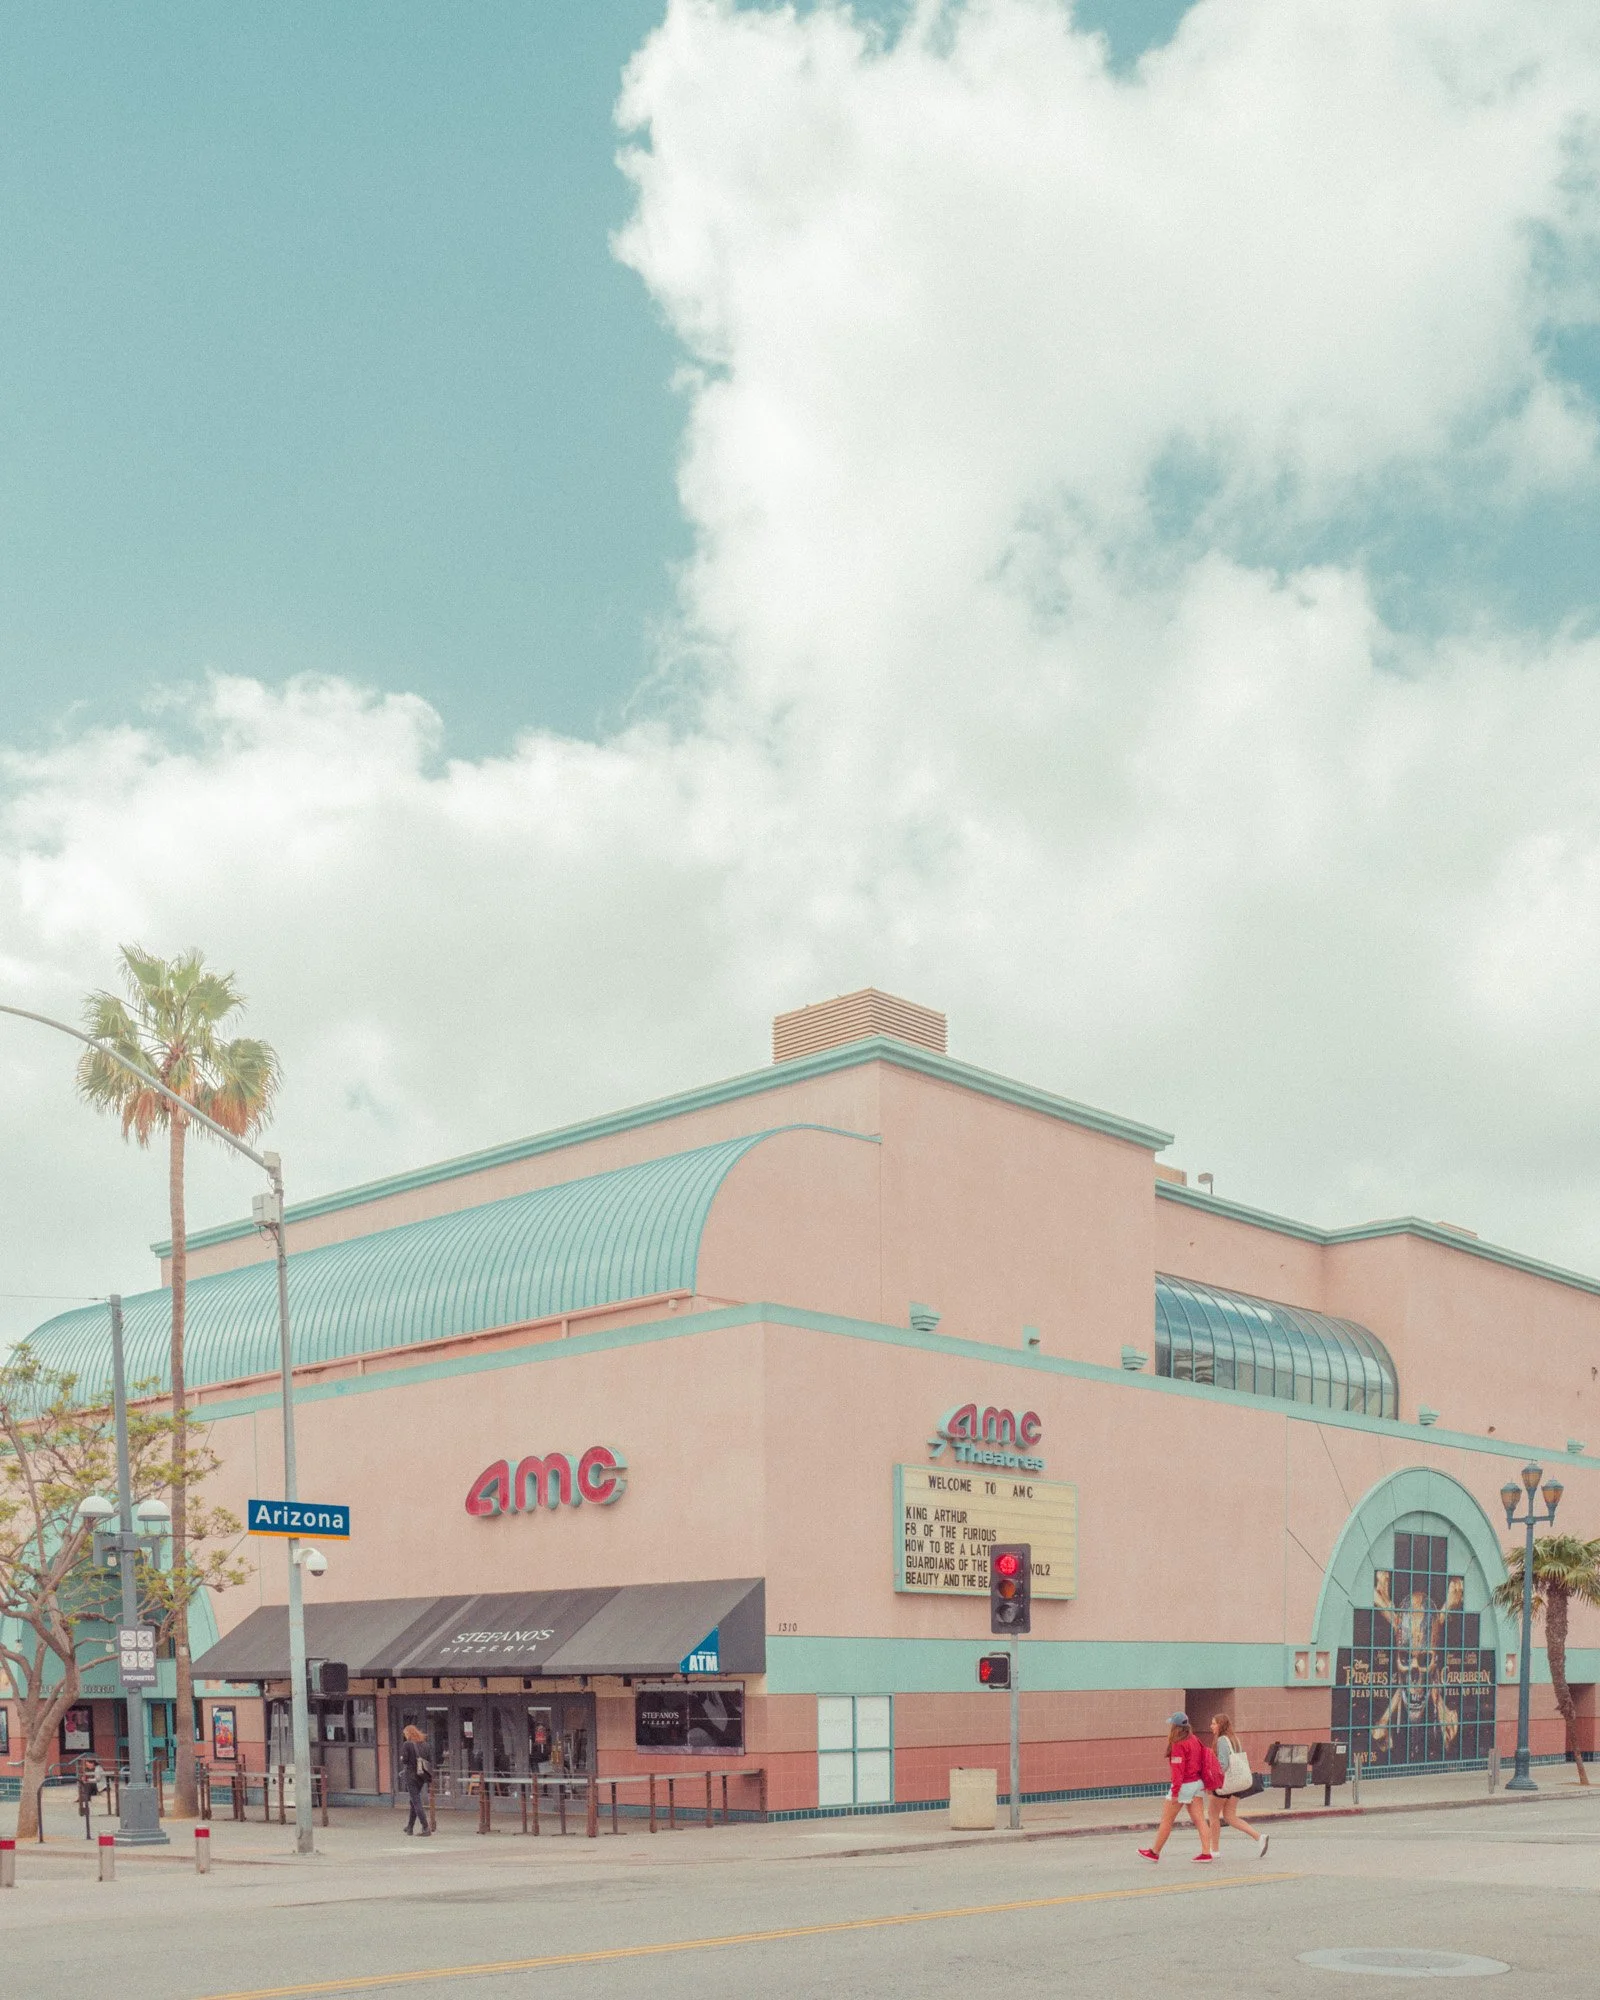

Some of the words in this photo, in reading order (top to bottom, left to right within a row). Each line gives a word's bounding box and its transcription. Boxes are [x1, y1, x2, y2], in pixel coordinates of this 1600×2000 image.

[940, 1403, 1042, 1446] AMC
[927, 1438, 947, 1458] 7
[952, 1442, 1045, 1470] Theatres
[465, 1445, 626, 1517] AMC
[928, 1475, 972, 1493] WELCOME
[985, 1481, 997, 1495] TO
[1012, 1485, 1034, 1499] AMC
[255, 1504, 344, 1529] Arizona
[906, 1506, 928, 1521] KING
[934, 1510, 968, 1524] ARTHUR
[905, 1522, 917, 1536] F8
[924, 1524, 934, 1537] OF
[940, 1525, 957, 1539] THE
[963, 1527, 997, 1542] FURIOUS
[905, 1539, 925, 1552] HOW
[930, 1540, 941, 1554] TO
[945, 1543, 955, 1555] BE
[960, 1544, 965, 1556] A
[970, 1544, 990, 1557] LATI
[906, 1555, 955, 1570] GUARDIANS
[959, 1559, 968, 1571] OF
[971, 1559, 988, 1572] THE
[905, 1571, 939, 1586] BEAUTY
[943, 1574, 960, 1587] AND
[962, 1574, 976, 1587] THE
[978, 1576, 991, 1588] BE
[778, 1622, 798, 1632] 1310
[452, 1629, 554, 1644] STEFANO'S
[440, 1644, 536, 1654] PIZZERIA
[689, 1655, 718, 1671] ATM
[642, 1711, 680, 1719] STEFANO'S
